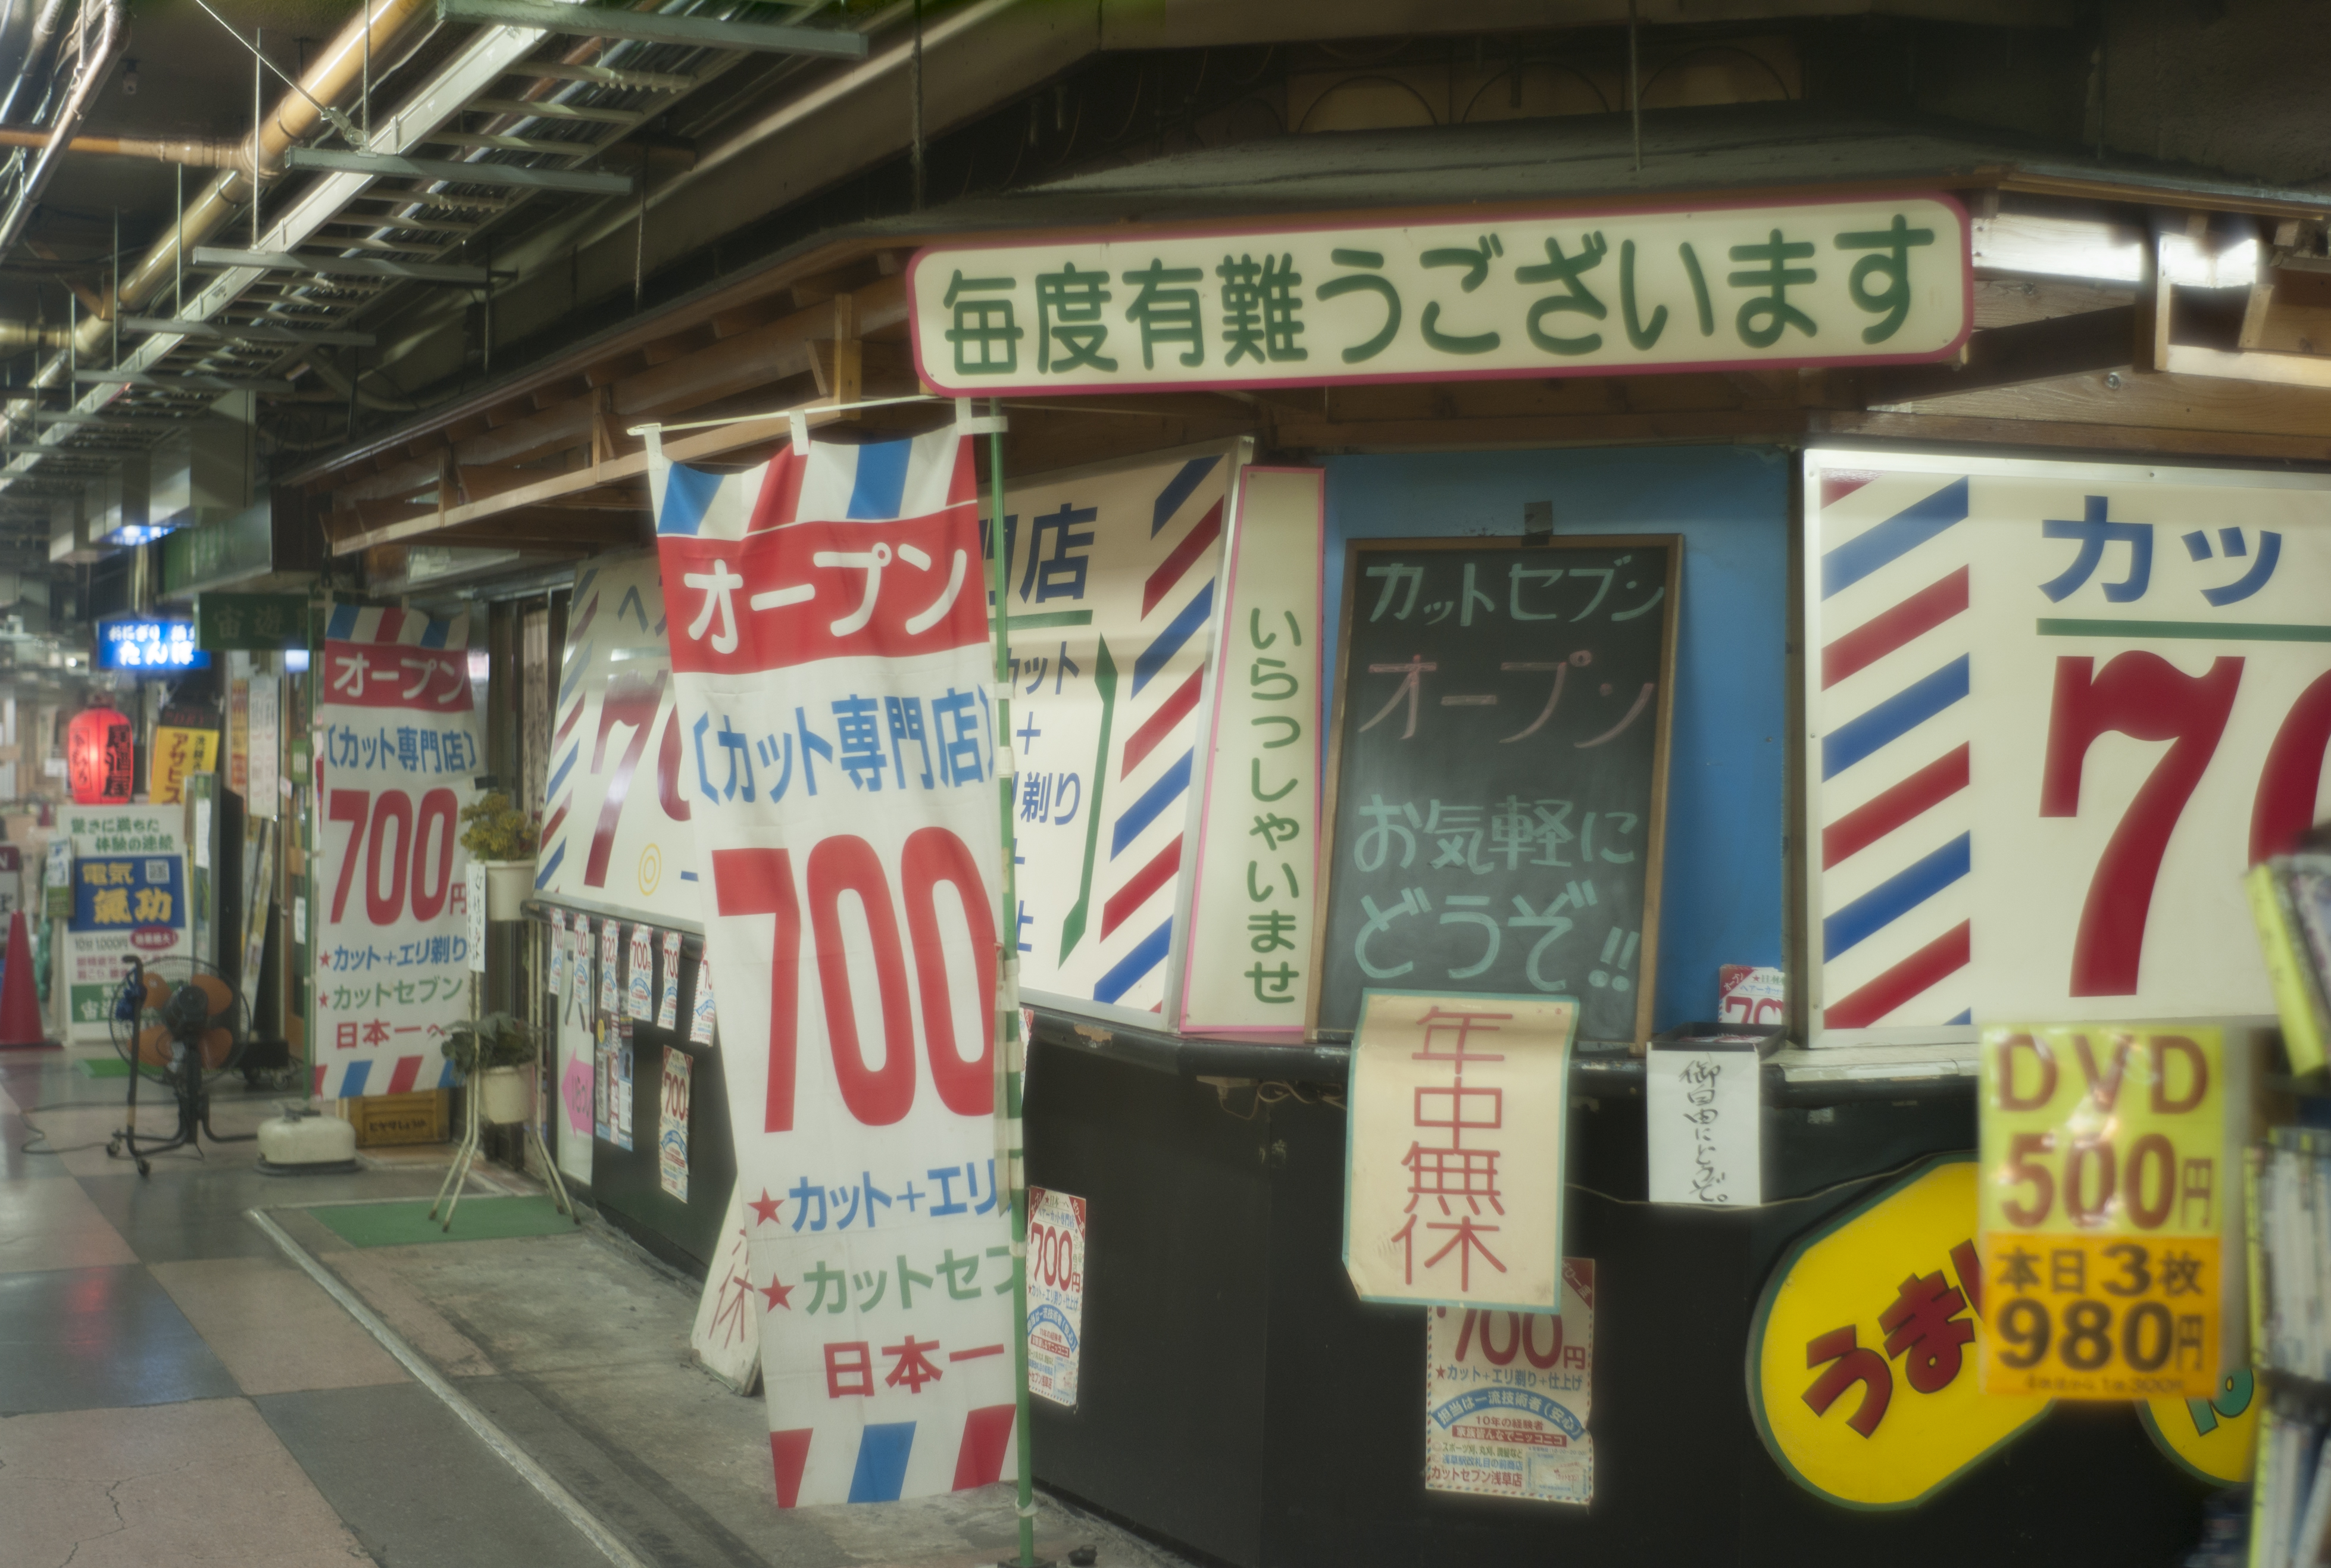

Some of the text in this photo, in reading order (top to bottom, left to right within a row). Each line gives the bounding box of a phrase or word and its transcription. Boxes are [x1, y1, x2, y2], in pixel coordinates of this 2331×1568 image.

[943, 214, 1936, 376] 毎度有難うございます
[1366, 555, 1664, 626] カットセブン
[2036, 495, 2282, 607] カッ
[684, 542, 967, 654] オープン
[333, 652, 465, 704] オープン
[1358, 649, 1654, 748] オープン
[1013, 771, 1080, 826] 剃り
[1353, 794, 1638, 874] お気軽に
[329, 787, 467, 926] 700円
[332, 975, 463, 1011] カットセブン
[711, 826, 1001, 1133] 700
[1995, 1033, 2210, 1116] DVD
[1391, 1006, 1513, 1292] 年中無休
[1998, 1132, 2214, 1231] 500円
[1996, 1242, 2205, 1298] 本日3枚
[823, 1335, 1005, 1398] 日本一
[1996, 1298, 2205, 1373] 980円
[1476, 1416, 1543, 1430] 10年の経験者
[1432, 1466, 1522, 1487] カットセブン浅草店
